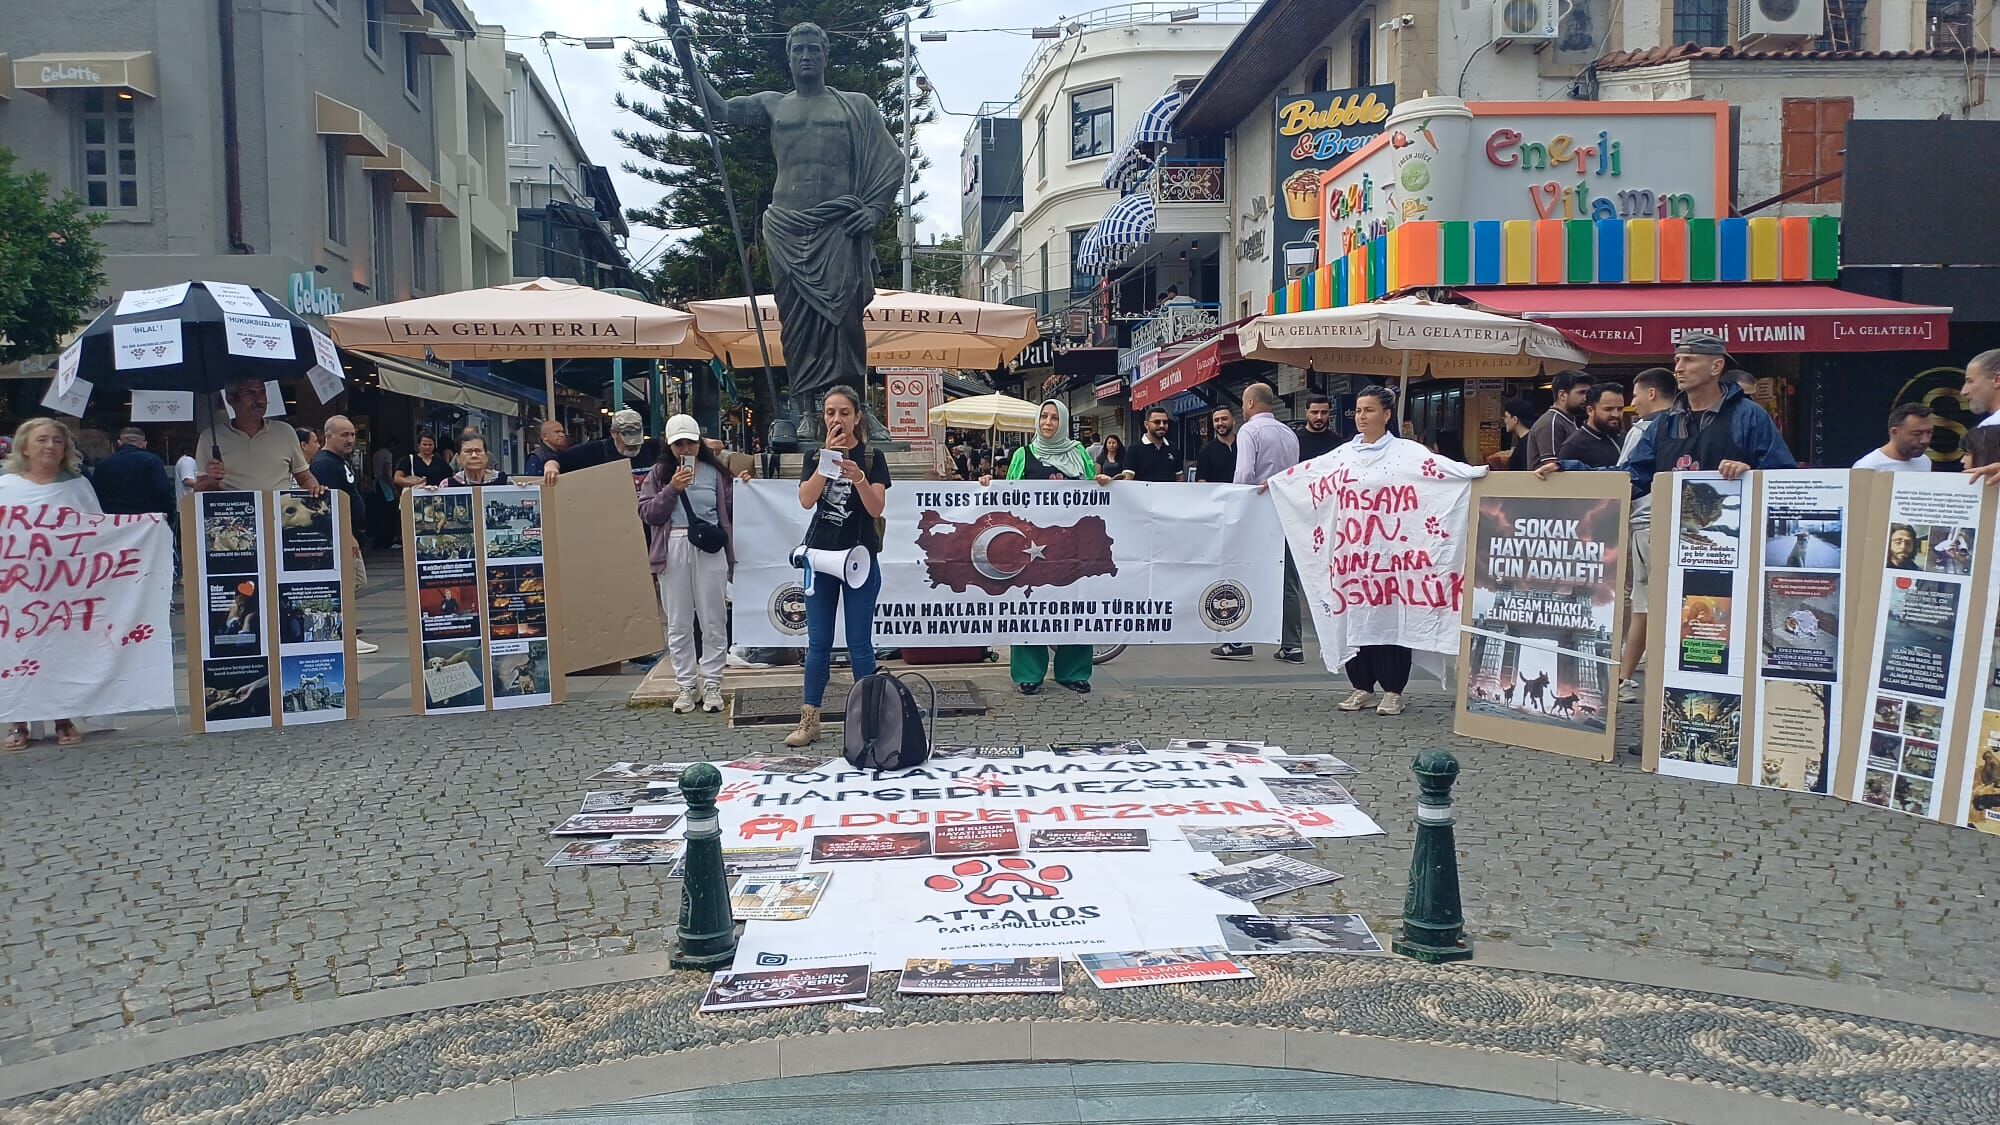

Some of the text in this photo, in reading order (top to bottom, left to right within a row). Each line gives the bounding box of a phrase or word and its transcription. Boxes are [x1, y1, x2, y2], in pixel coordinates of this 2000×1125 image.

[1279, 92, 1389, 136] Bubble
[404, 321, 621, 337] LA GELATERIA
[1270, 325, 1363, 336] LA GELATERIA
[1397, 325, 1511, 341] LA GELATERIA
[1737, 322, 1805, 342] VİTAMİN
[1840, 325, 1926, 335] LA GELATERIA
[916, 489, 1111, 508] TEK SES TEK GÜÇ TEK ÇÖZÜM
[1513, 518, 1580, 540] SOKAK
[1489, 537, 1605, 562] HAYVANLARI
[1527, 560, 1605, 584] ADALET!
[921, 602, 994, 617] HAKLARI
[999, 601, 1098, 616] PLATFORMU
[1101, 598, 1173, 615] TÜRKİYE
[1544, 601, 1582, 616] HAKKI
[927, 619, 993, 634] HAYVAN
[998, 618, 1069, 634] HAKLARI
[1073, 617, 1172, 633] PLATFORMU
[1486, 606, 1597, 630] ELİNDEN ALINAMAZ
[915, 905, 1101, 924] ATTALOS
[1138, 964, 1195, 974] ÖLMEK
[737, 977, 845, 990] KULAK VERİN
